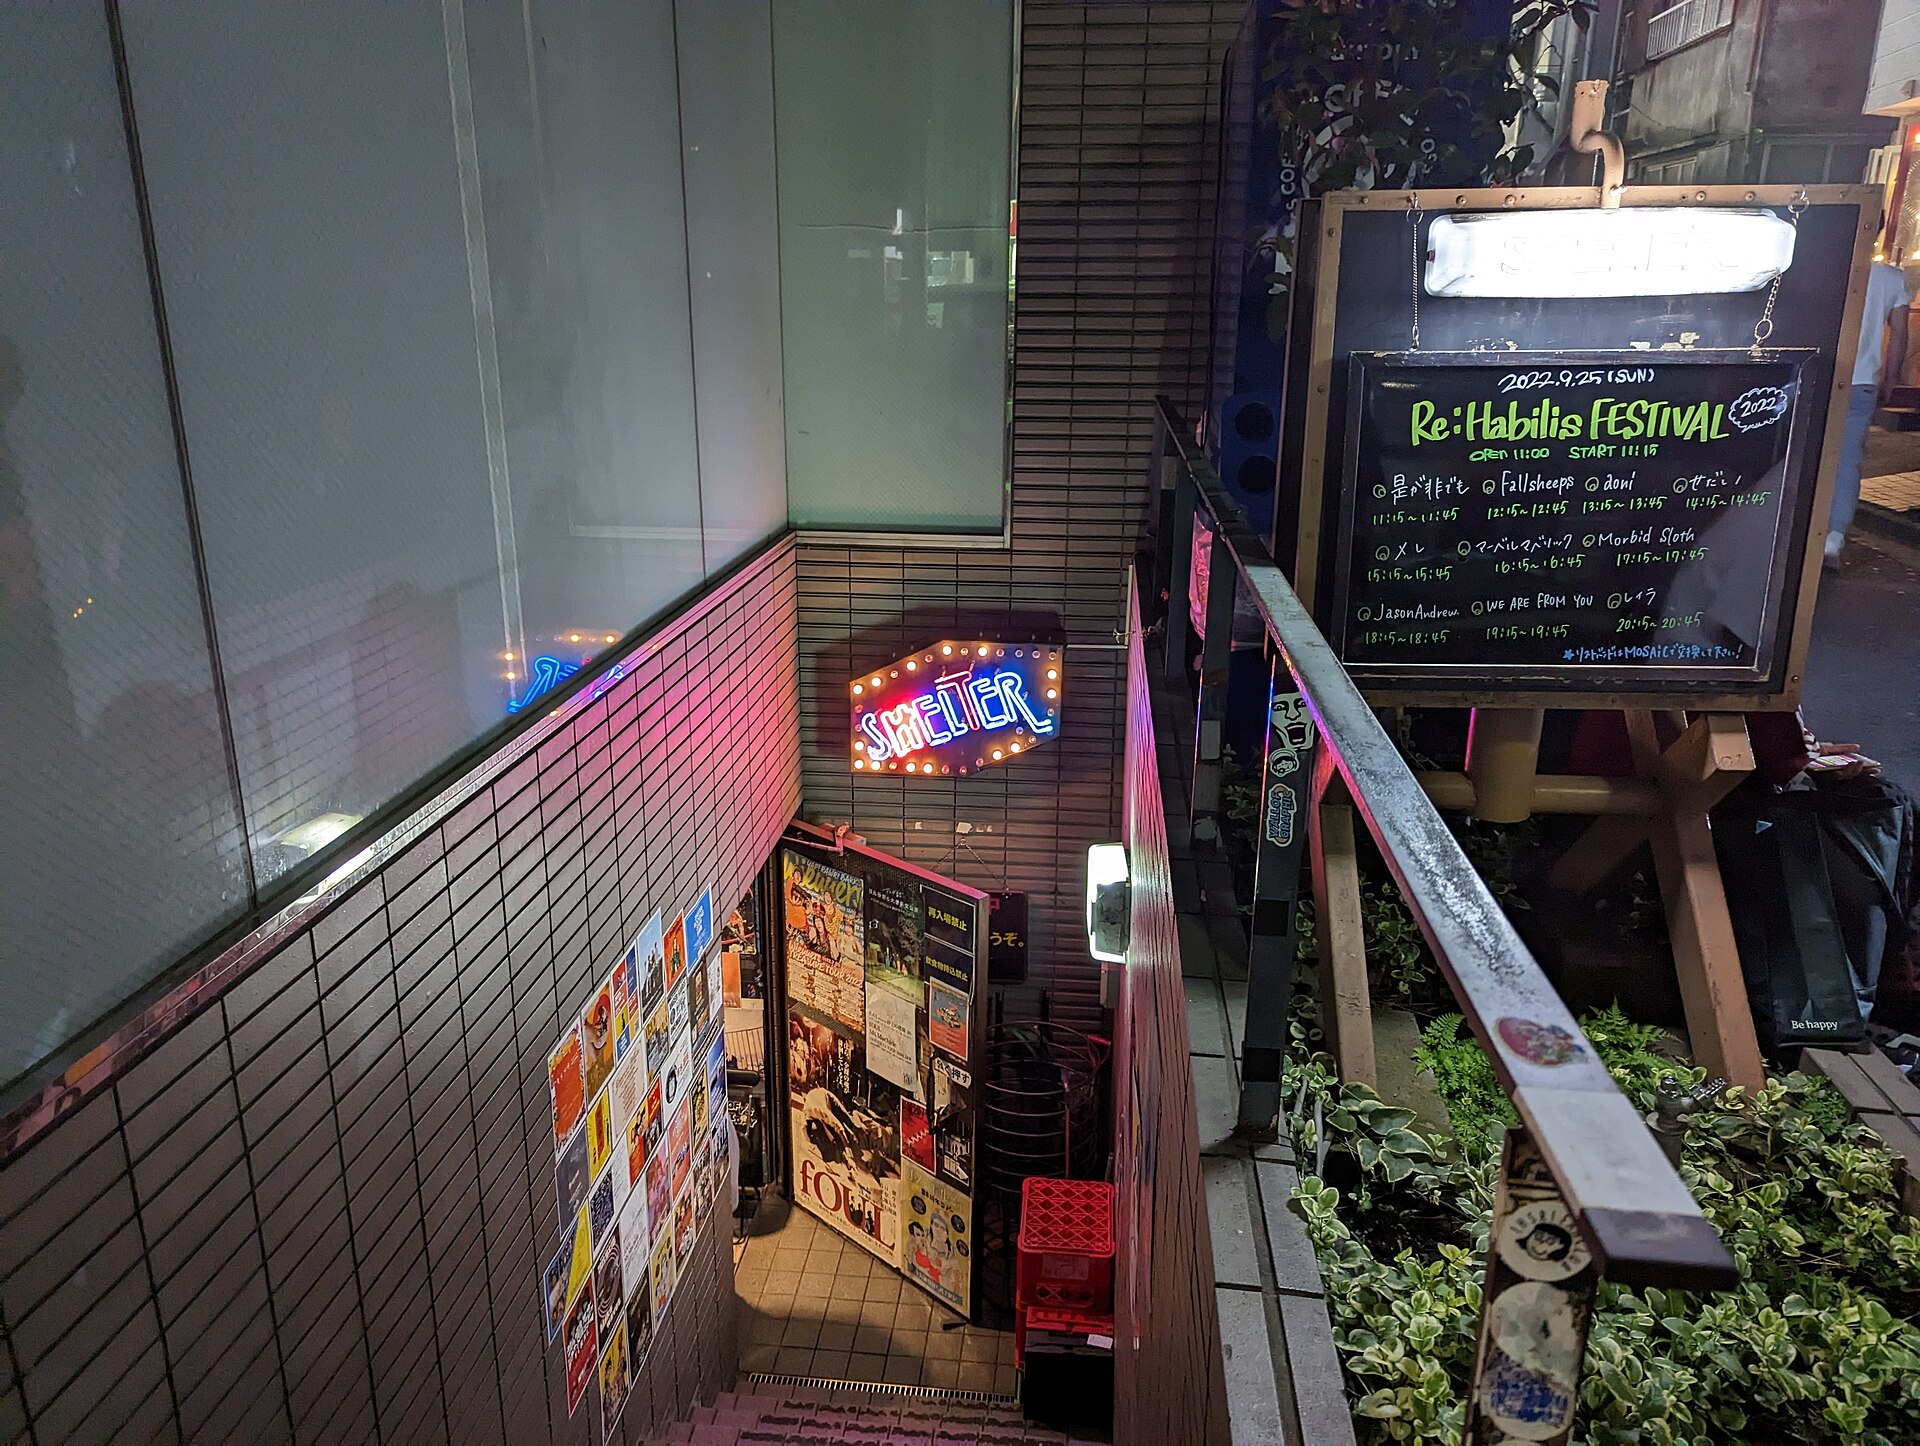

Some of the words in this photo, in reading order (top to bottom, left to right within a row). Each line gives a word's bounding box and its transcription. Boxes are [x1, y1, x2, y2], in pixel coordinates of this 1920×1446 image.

[1608, 367, 1655, 384] (SUN)
[1739, 397, 1777, 418] 2022
[1411, 397, 1583, 446] Re:Habilis
[1589, 397, 1730, 443] FESTIVAL
[1513, 447, 1550, 460] 11:00
[1568, 443, 1617, 459] START
[1621, 443, 1659, 458] 11:15
[1501, 470, 1575, 496] Fallsheeps
[1598, 526, 1652, 547] Morbid
[1659, 526, 1695, 546] Sloth
[1486, 600, 1505, 613] WE
[1509, 597, 1530, 612] ARE
[1537, 592, 1566, 609] FROM
[1573, 594, 1594, 607] YOU
[1791, 1020, 1805, 1029] Be
[1805, 1020, 1838, 1030] happy
